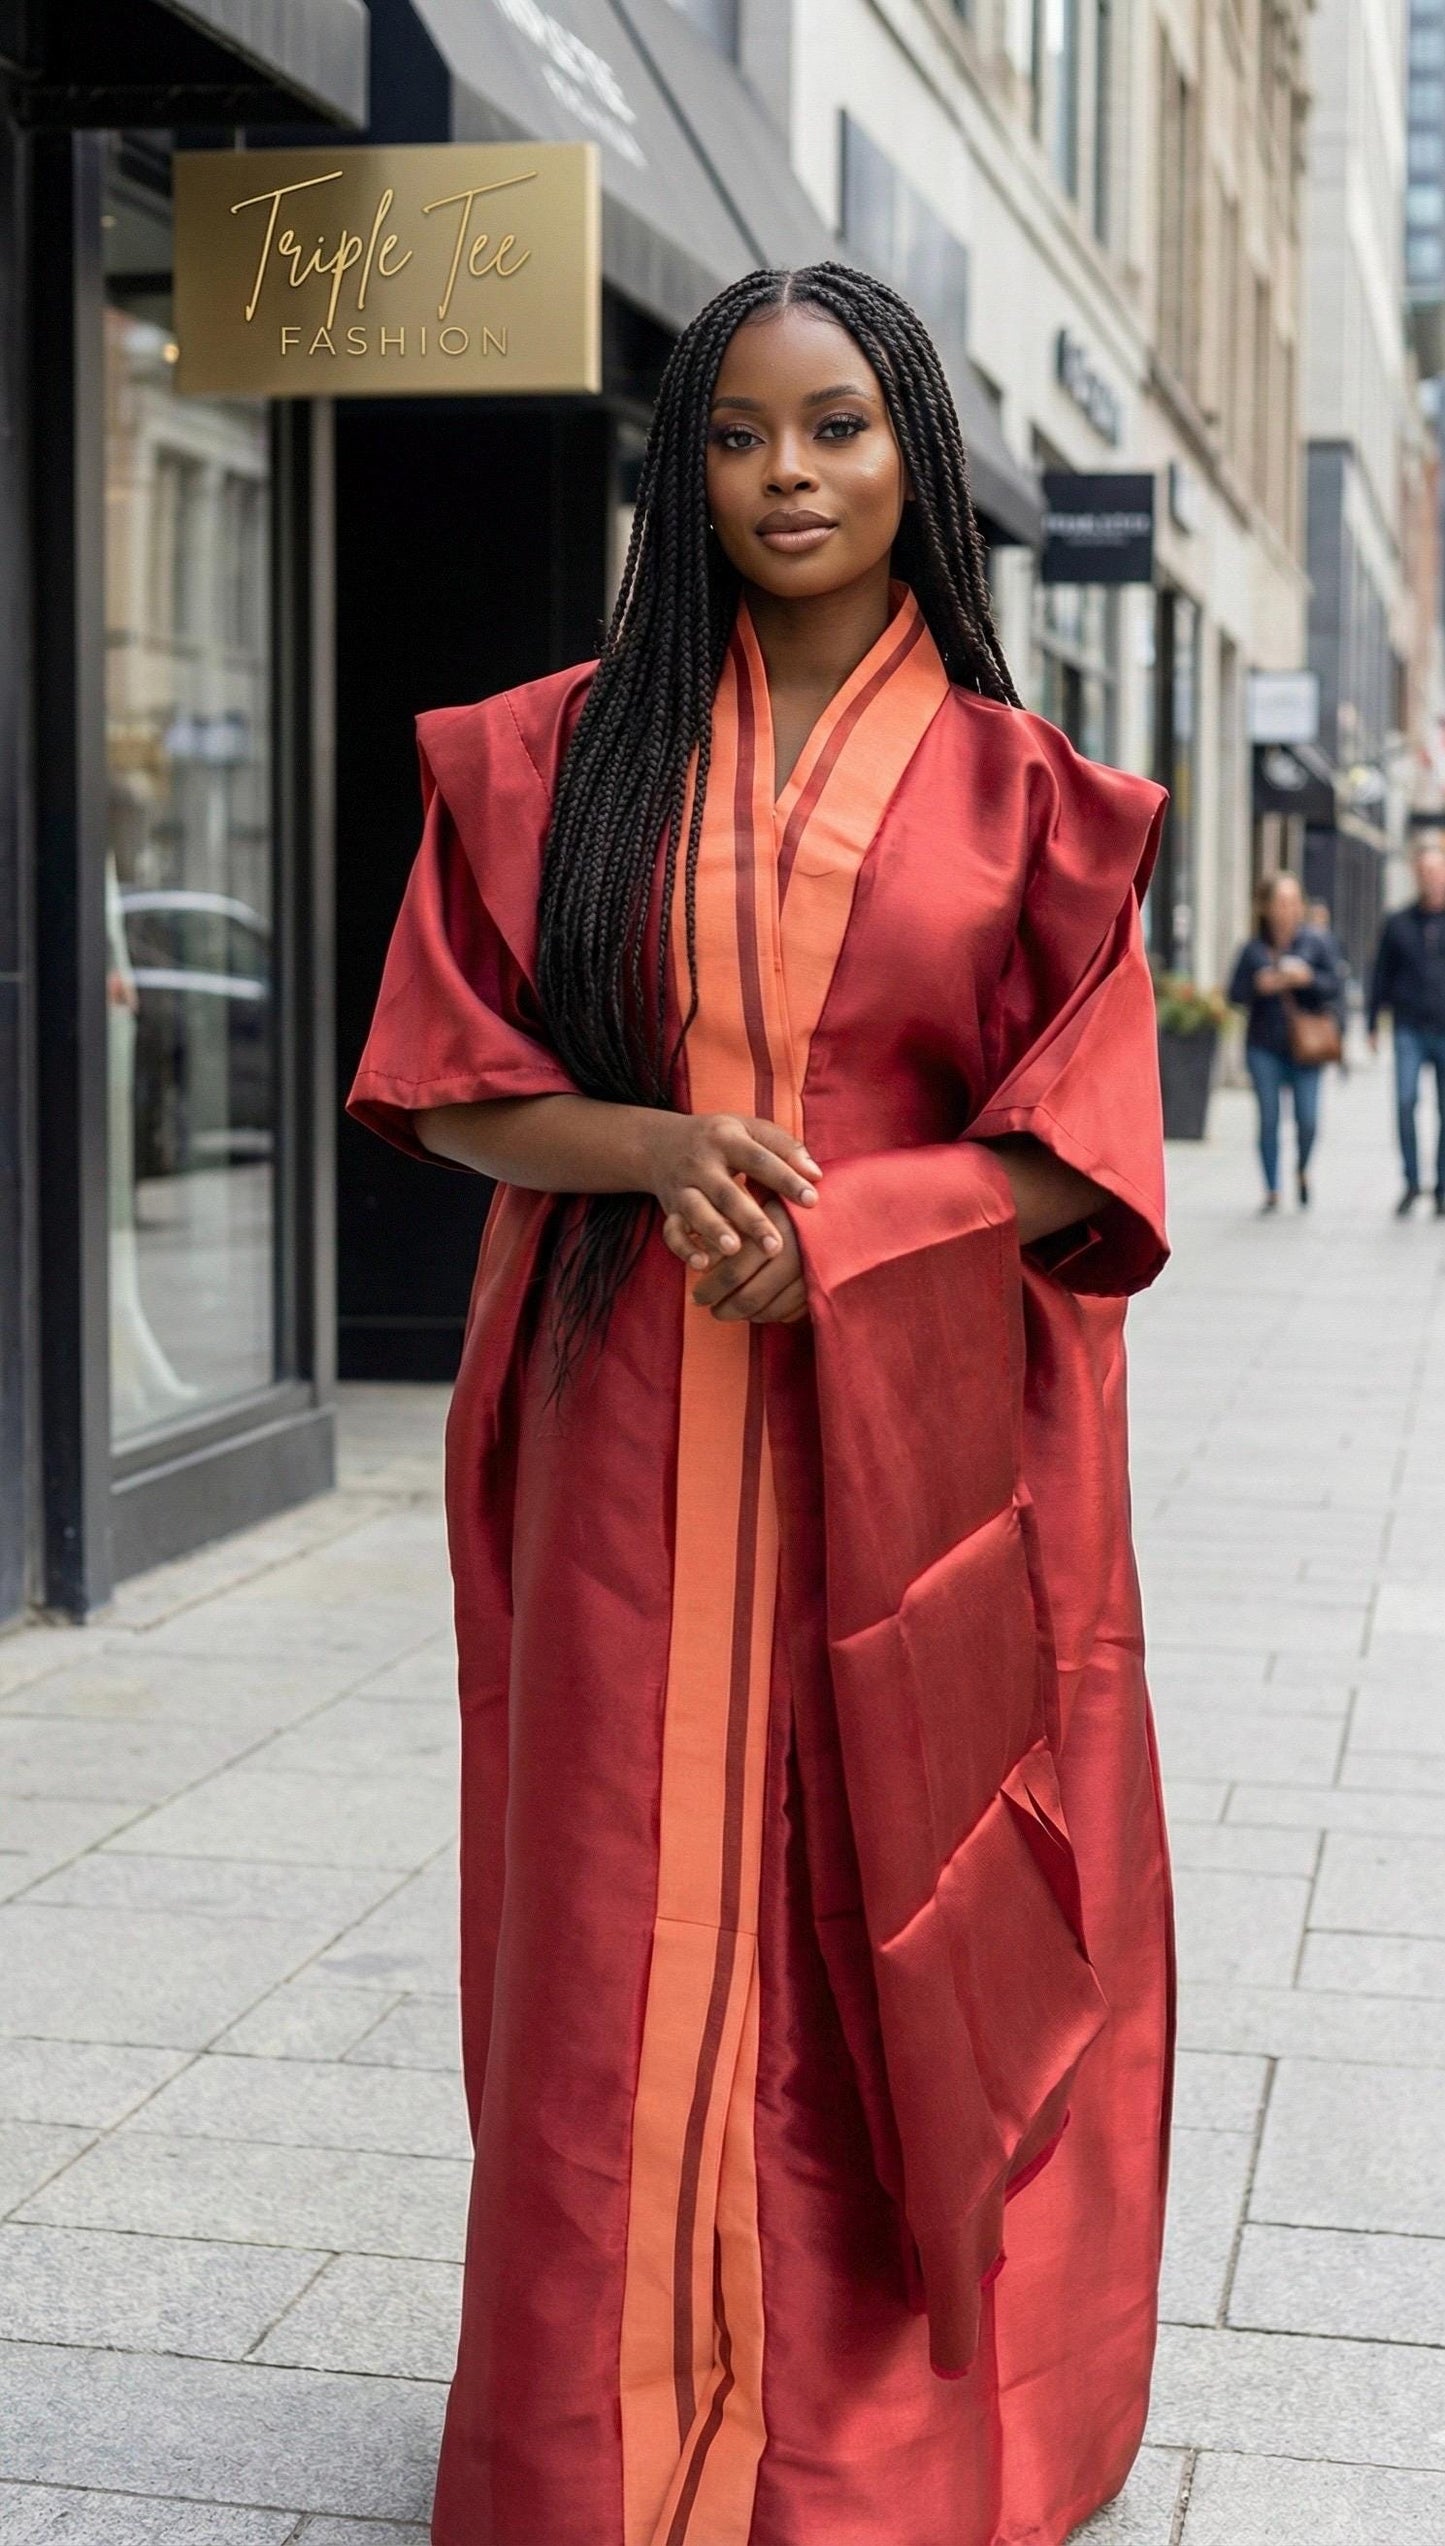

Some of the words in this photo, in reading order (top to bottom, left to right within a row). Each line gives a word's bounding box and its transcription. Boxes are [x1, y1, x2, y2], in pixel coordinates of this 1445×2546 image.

[230, 170, 413, 330] Triple
[422, 170, 538, 320] Tee
[280, 326, 509, 356] FASHION
